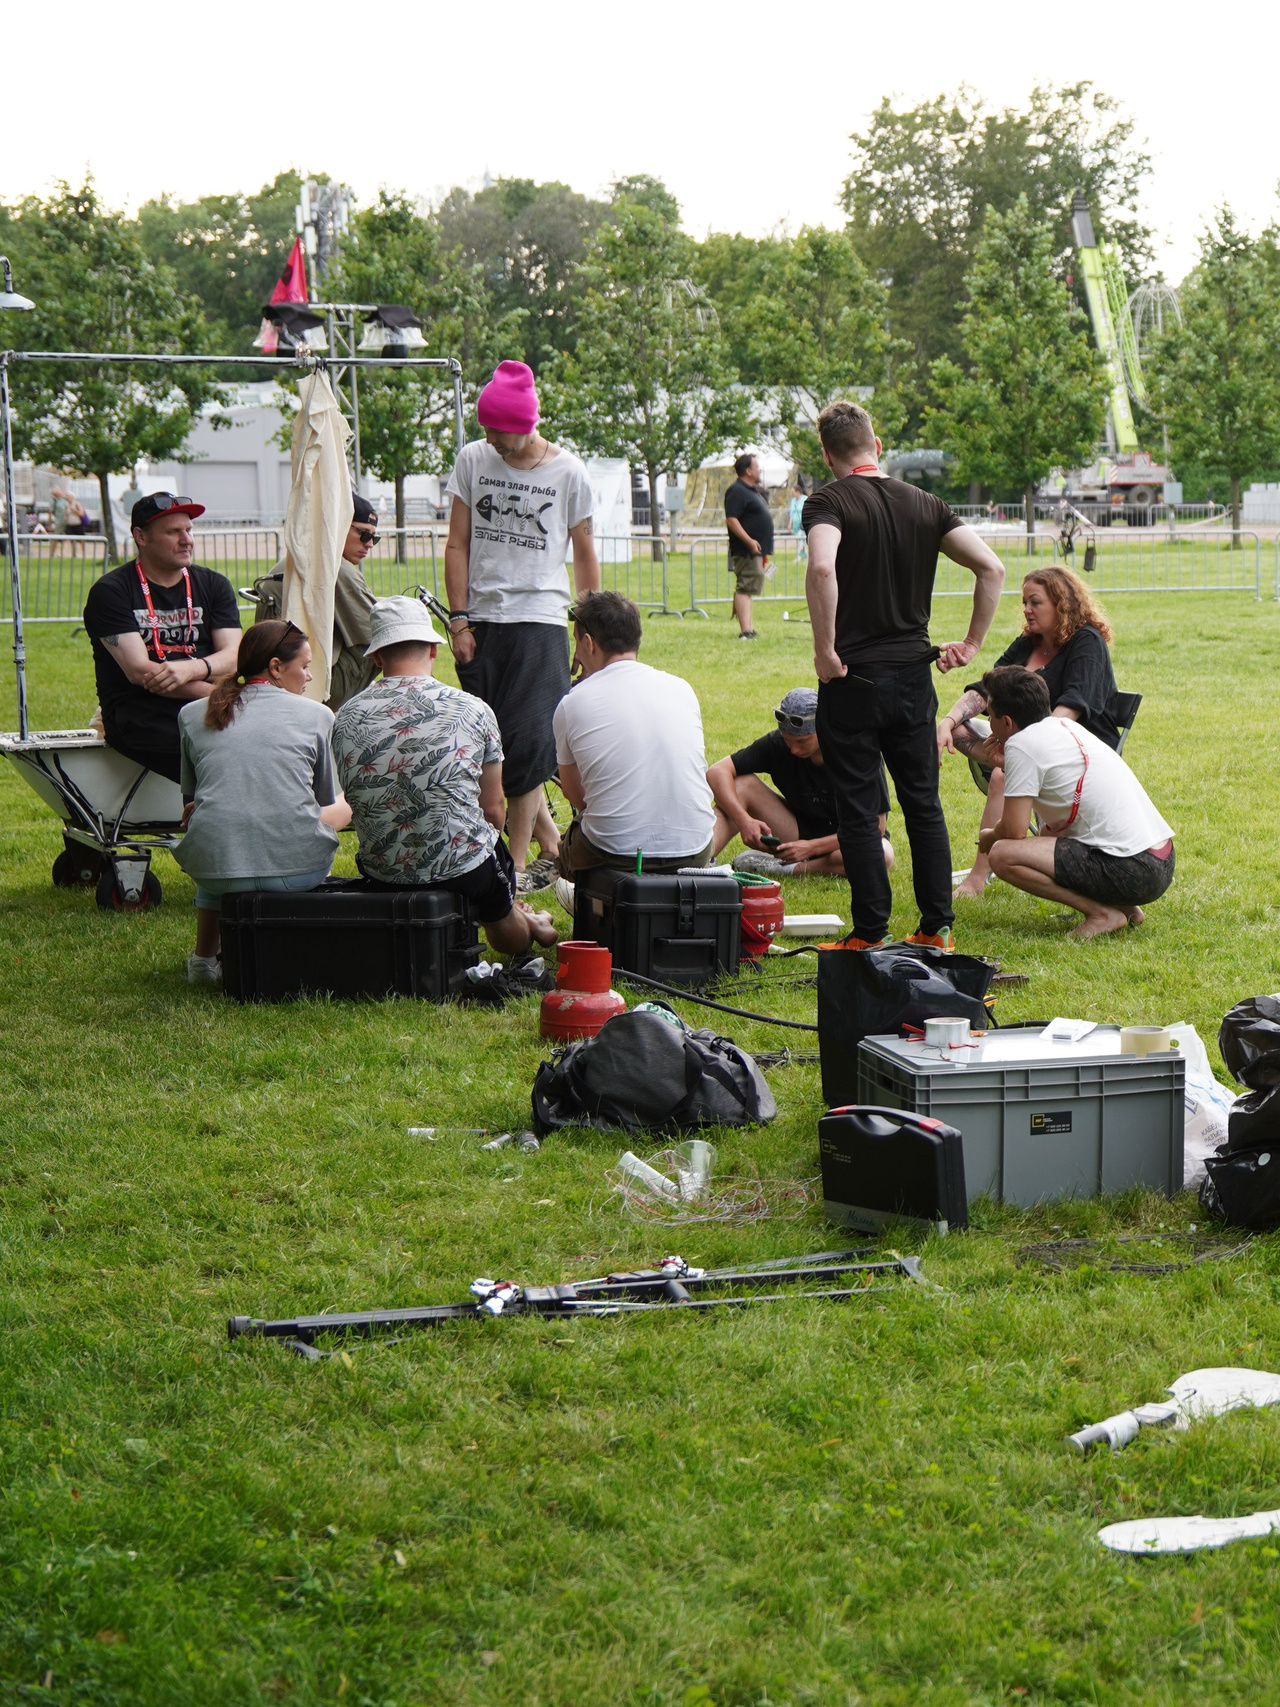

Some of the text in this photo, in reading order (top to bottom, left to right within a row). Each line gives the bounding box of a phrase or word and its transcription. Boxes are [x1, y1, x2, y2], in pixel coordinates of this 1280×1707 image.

[479, 476, 557, 497] Самая злая рыба
[475, 531, 507, 543] ЗЛЫЕ
[509, 537, 547, 551] РЫБЫ
